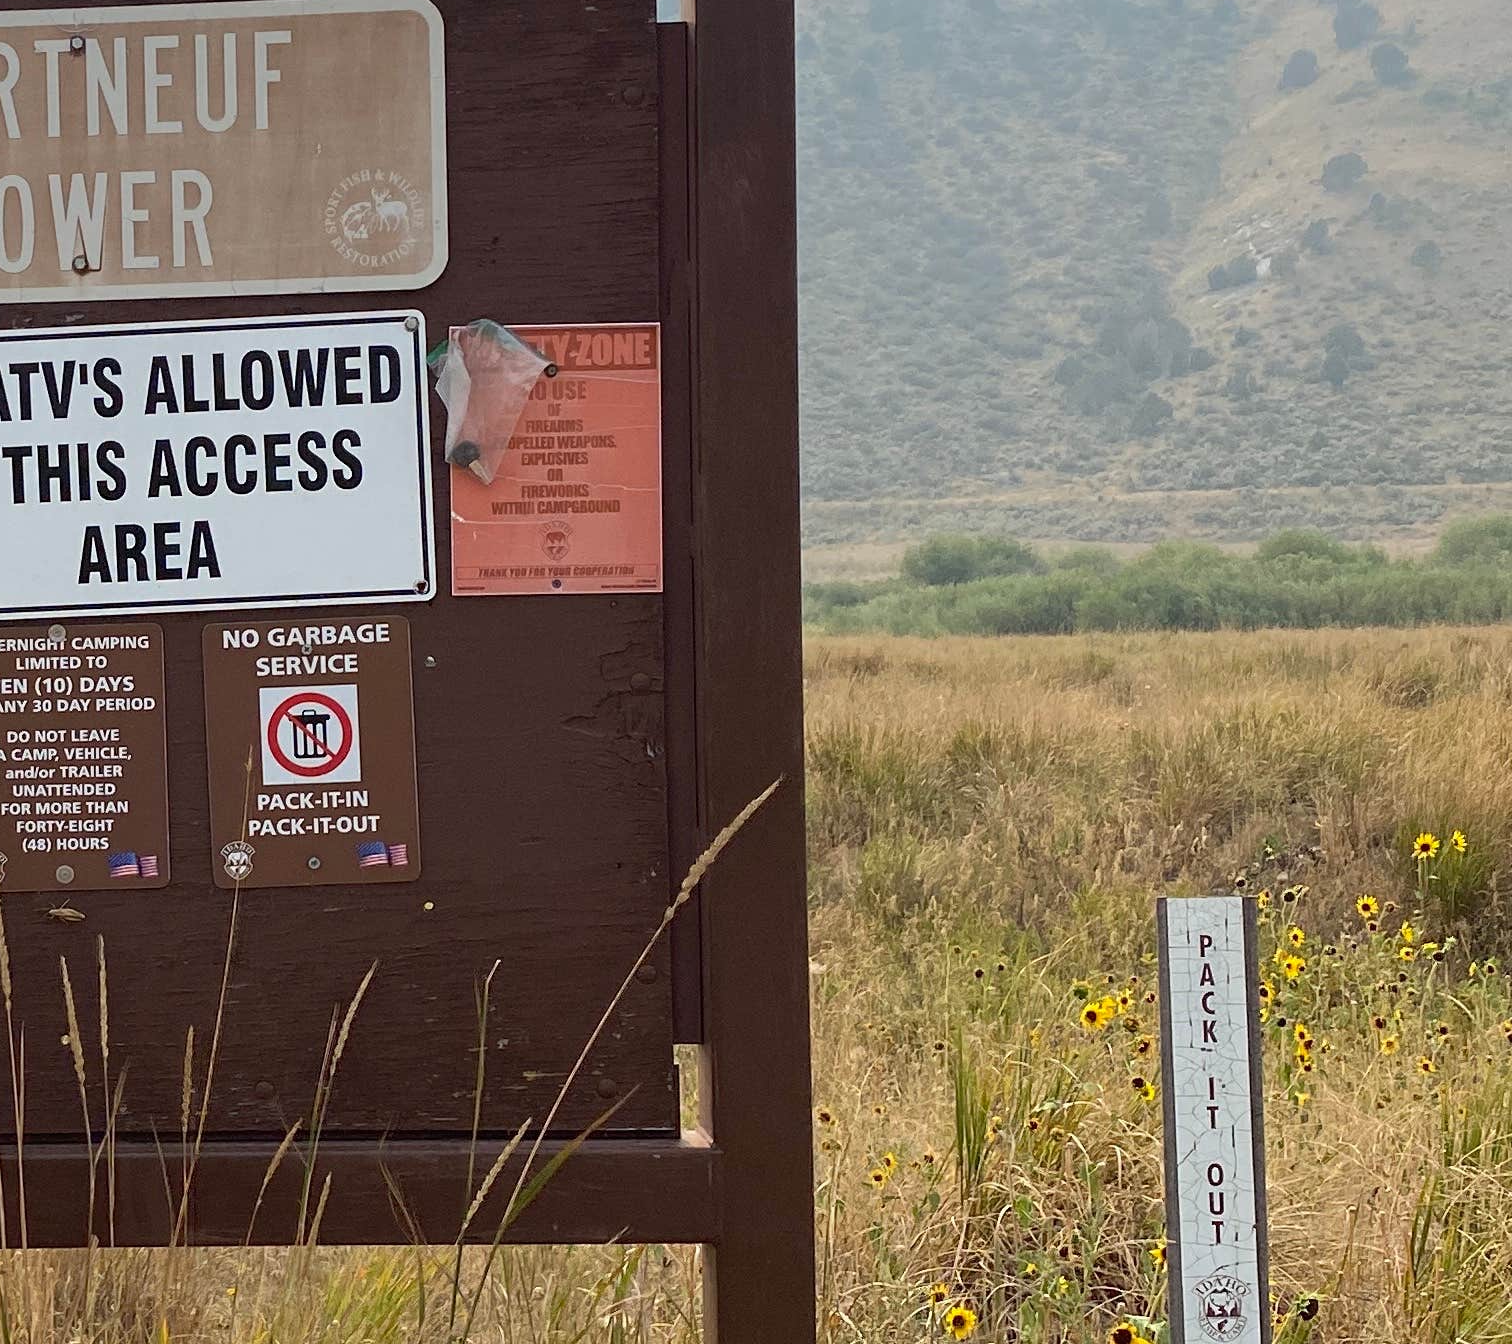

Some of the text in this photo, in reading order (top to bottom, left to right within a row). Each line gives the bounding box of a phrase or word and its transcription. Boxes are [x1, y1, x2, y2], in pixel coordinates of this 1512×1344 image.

[145, 344, 402, 417] ALLOWED
[552, 381, 587, 400] USE
[525, 419, 584, 433] FIREARMS
[2, 438, 128, 503] THIS
[149, 429, 364, 498] ACCESS
[521, 452, 589, 466] EXPLOSIVES
[547, 468, 563, 481] OR
[521, 484, 589, 499] FIREWORKS
[491, 500, 621, 515] WITHIN CAMPGROUND
[77, 520, 222, 585] AREA
[71, 635, 150, 651] CAMPING
[223, 624, 390, 649] NO GARBAGE
[16, 656, 108, 670] LIMITED TO
[256, 654, 359, 677] SERVICE
[34, 677, 73, 696] (10)
[79, 676, 135, 692] DAYS
[32, 699, 51, 713] 30
[57, 698, 91, 712] DAY
[96, 697, 156, 711] PERIOD
[7, 729, 120, 744] DO NOT LEAVE
[11, 748, 59, 762] CAMP,
[64, 747, 132, 761] VEHICLE,
[5, 765, 123, 780] and/or TRAILER
[12, 783, 116, 797] UNATTENDED
[1, 801, 129, 816] FOR MORE THAN
[257, 790, 369, 811] PACK-IT-IN
[16, 819, 114, 833] FORTY-EIGHT
[248, 816, 380, 836] PACK-IT-OUT
[22, 837, 110, 853] (48) HOURS
[1199, 934, 1225, 1245] PACK IT OUT
[1195, 1277, 1247, 1295] IDAHO
